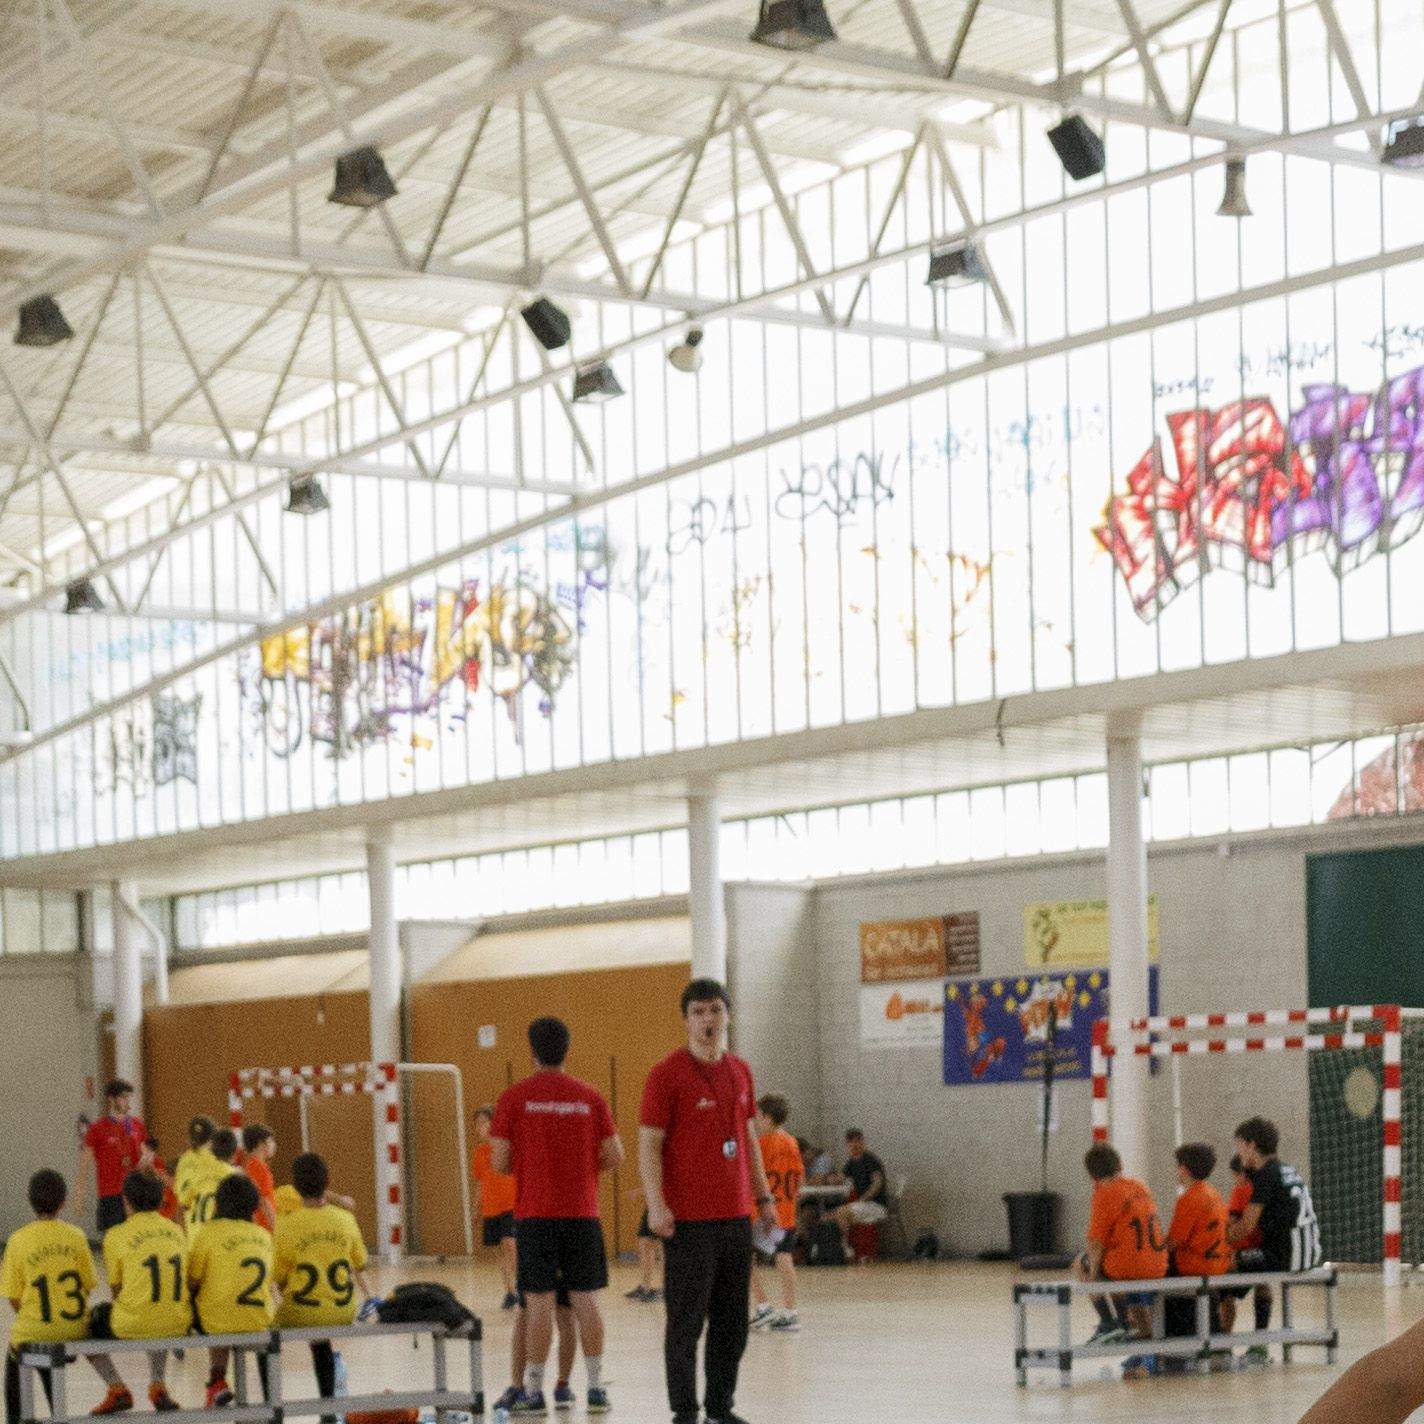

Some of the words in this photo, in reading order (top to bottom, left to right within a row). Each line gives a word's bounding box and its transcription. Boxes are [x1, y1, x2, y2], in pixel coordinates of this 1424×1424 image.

[30, 1268, 86, 1324] 13
[141, 1252, 182, 1303] 11
[236, 1256, 268, 1308] 2
[292, 1257, 354, 1308] 29
